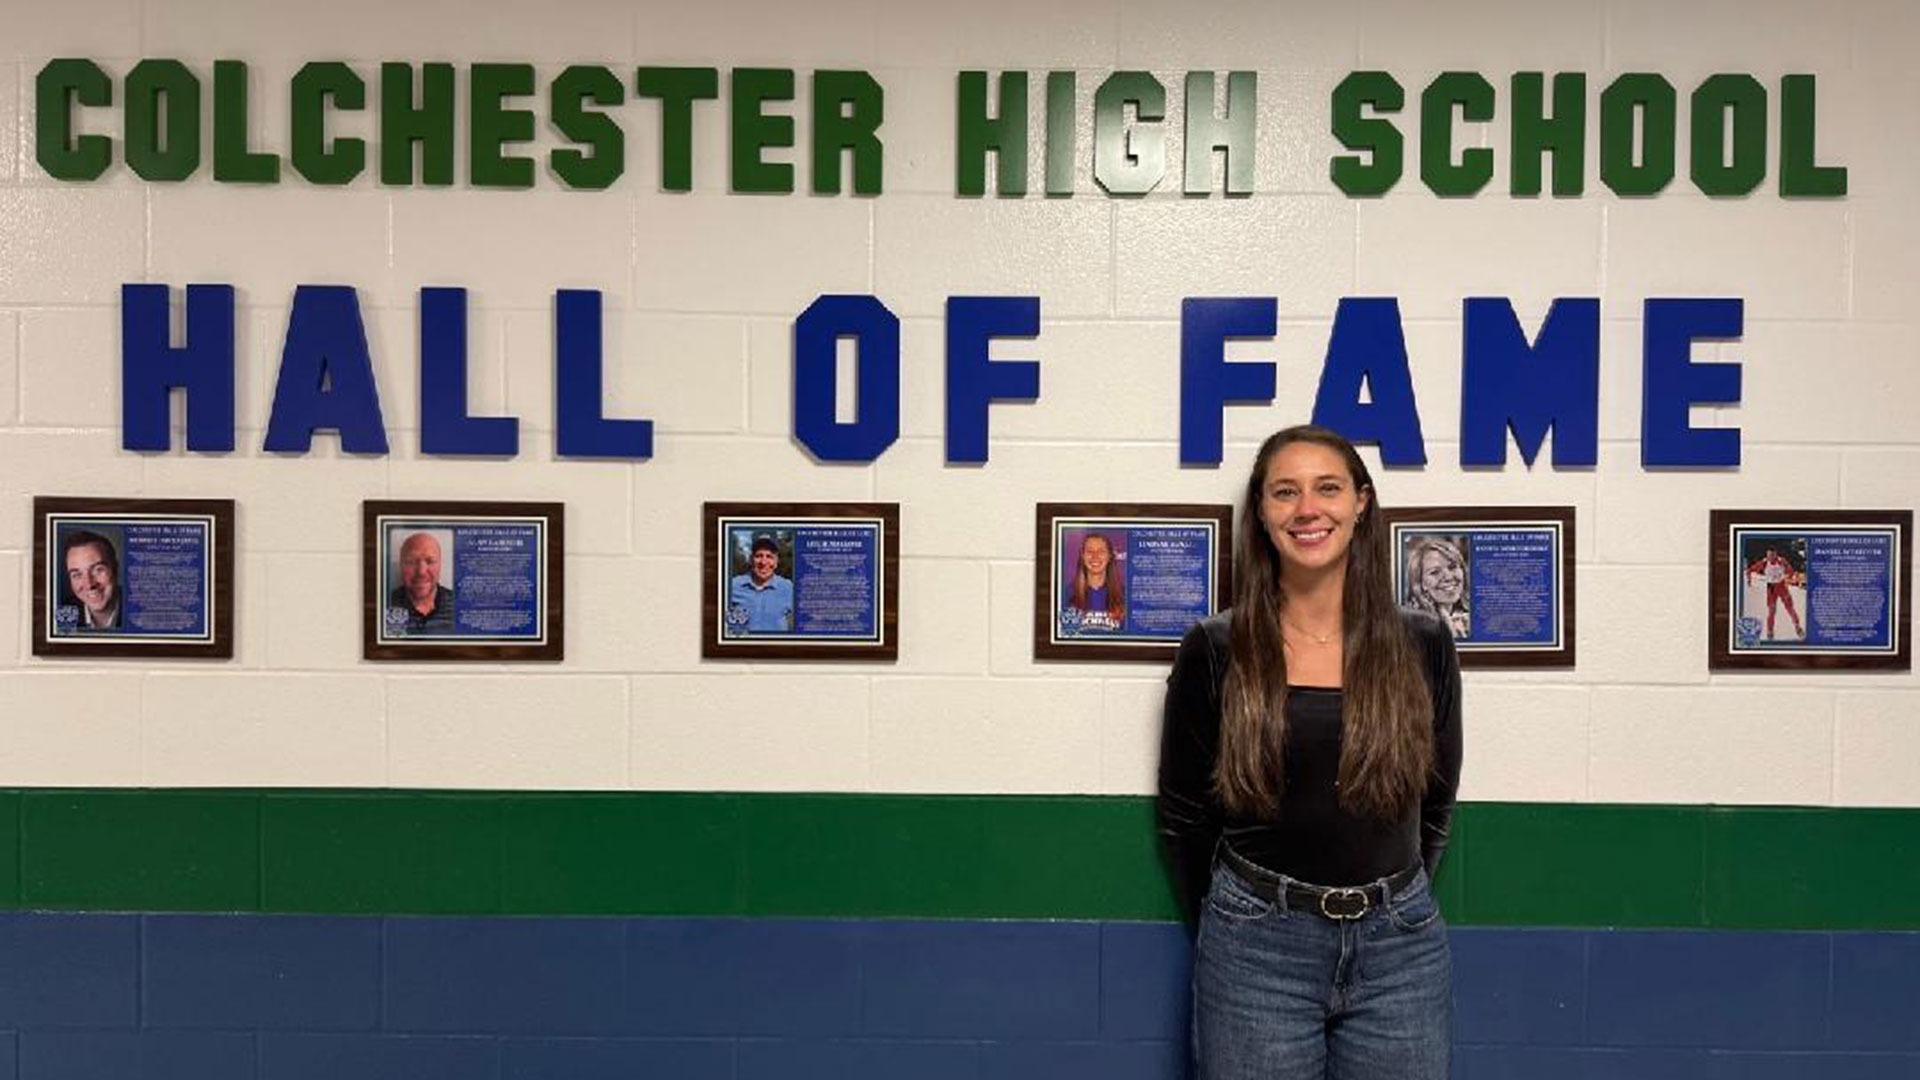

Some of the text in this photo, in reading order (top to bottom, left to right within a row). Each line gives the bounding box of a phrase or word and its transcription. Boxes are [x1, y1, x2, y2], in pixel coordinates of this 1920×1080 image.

[36, 59, 1848, 197] COLCHESTER HIGH SCHOOL
[122, 284, 1743, 467] HALL OF FAME
